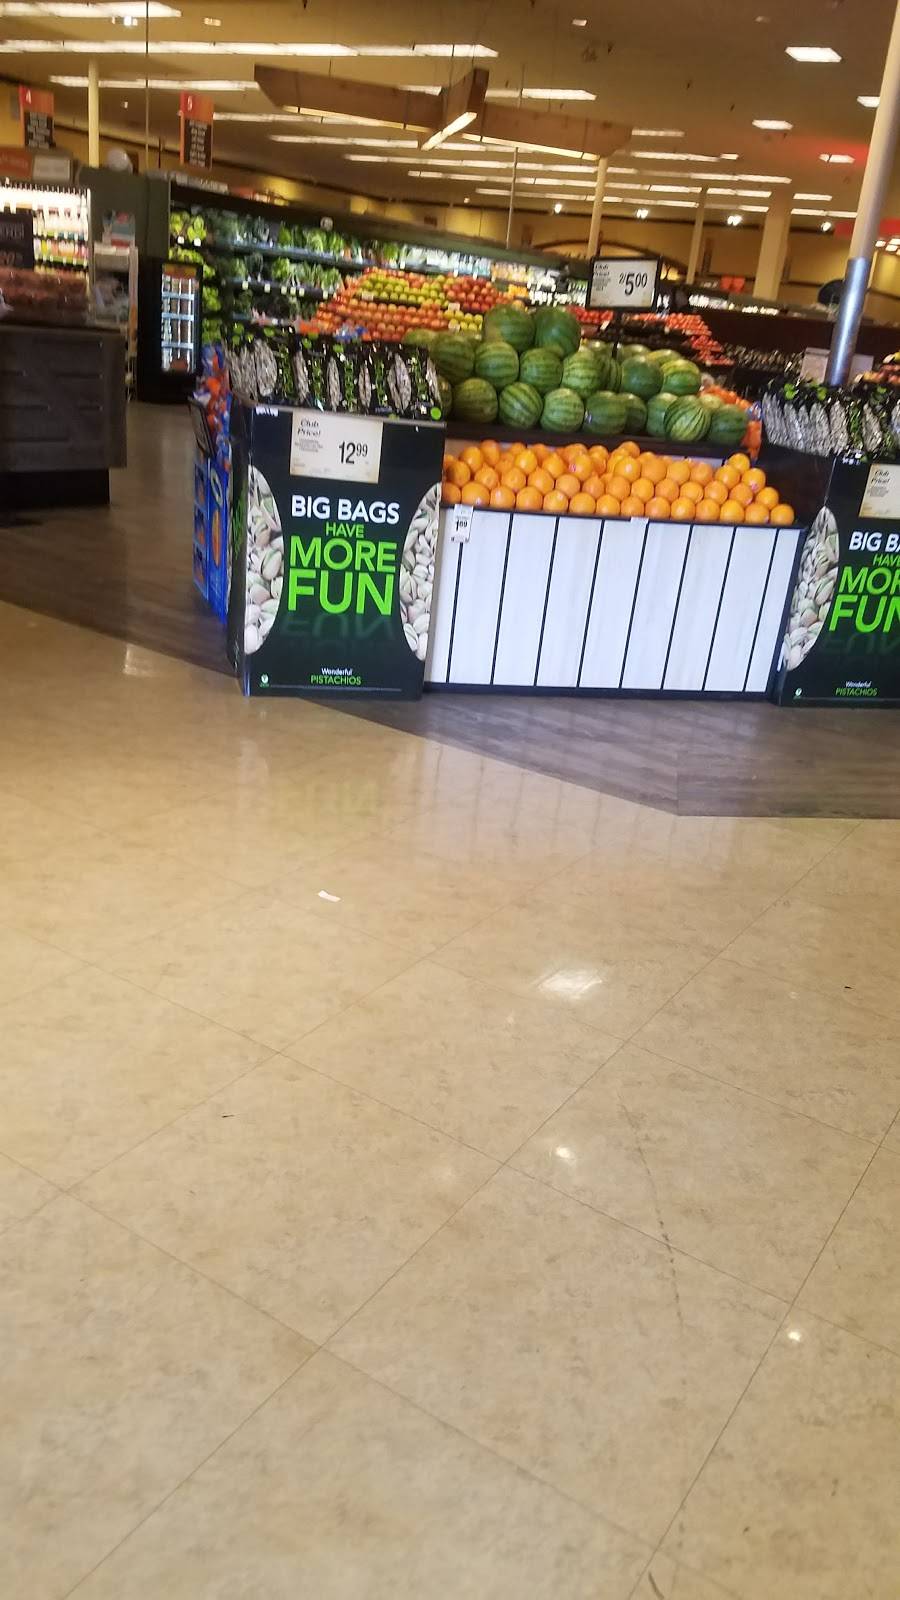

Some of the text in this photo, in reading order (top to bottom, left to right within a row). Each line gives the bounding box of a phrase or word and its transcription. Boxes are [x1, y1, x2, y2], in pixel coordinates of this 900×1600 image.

[300, 418, 319, 428] Club
[297, 427, 321, 437] Price!
[291, 494, 400, 525] BIG BAGS
[325, 521, 365, 539] HAVE
[848, 531, 883, 552] BIG
[290, 535, 398, 573] MORE
[287, 567, 395, 616] FUN
[321, 667, 353, 676] Wonderful
[310, 674, 362, 686] PISTACHIOS
[835, 687, 878, 697] PISTACHIOS
